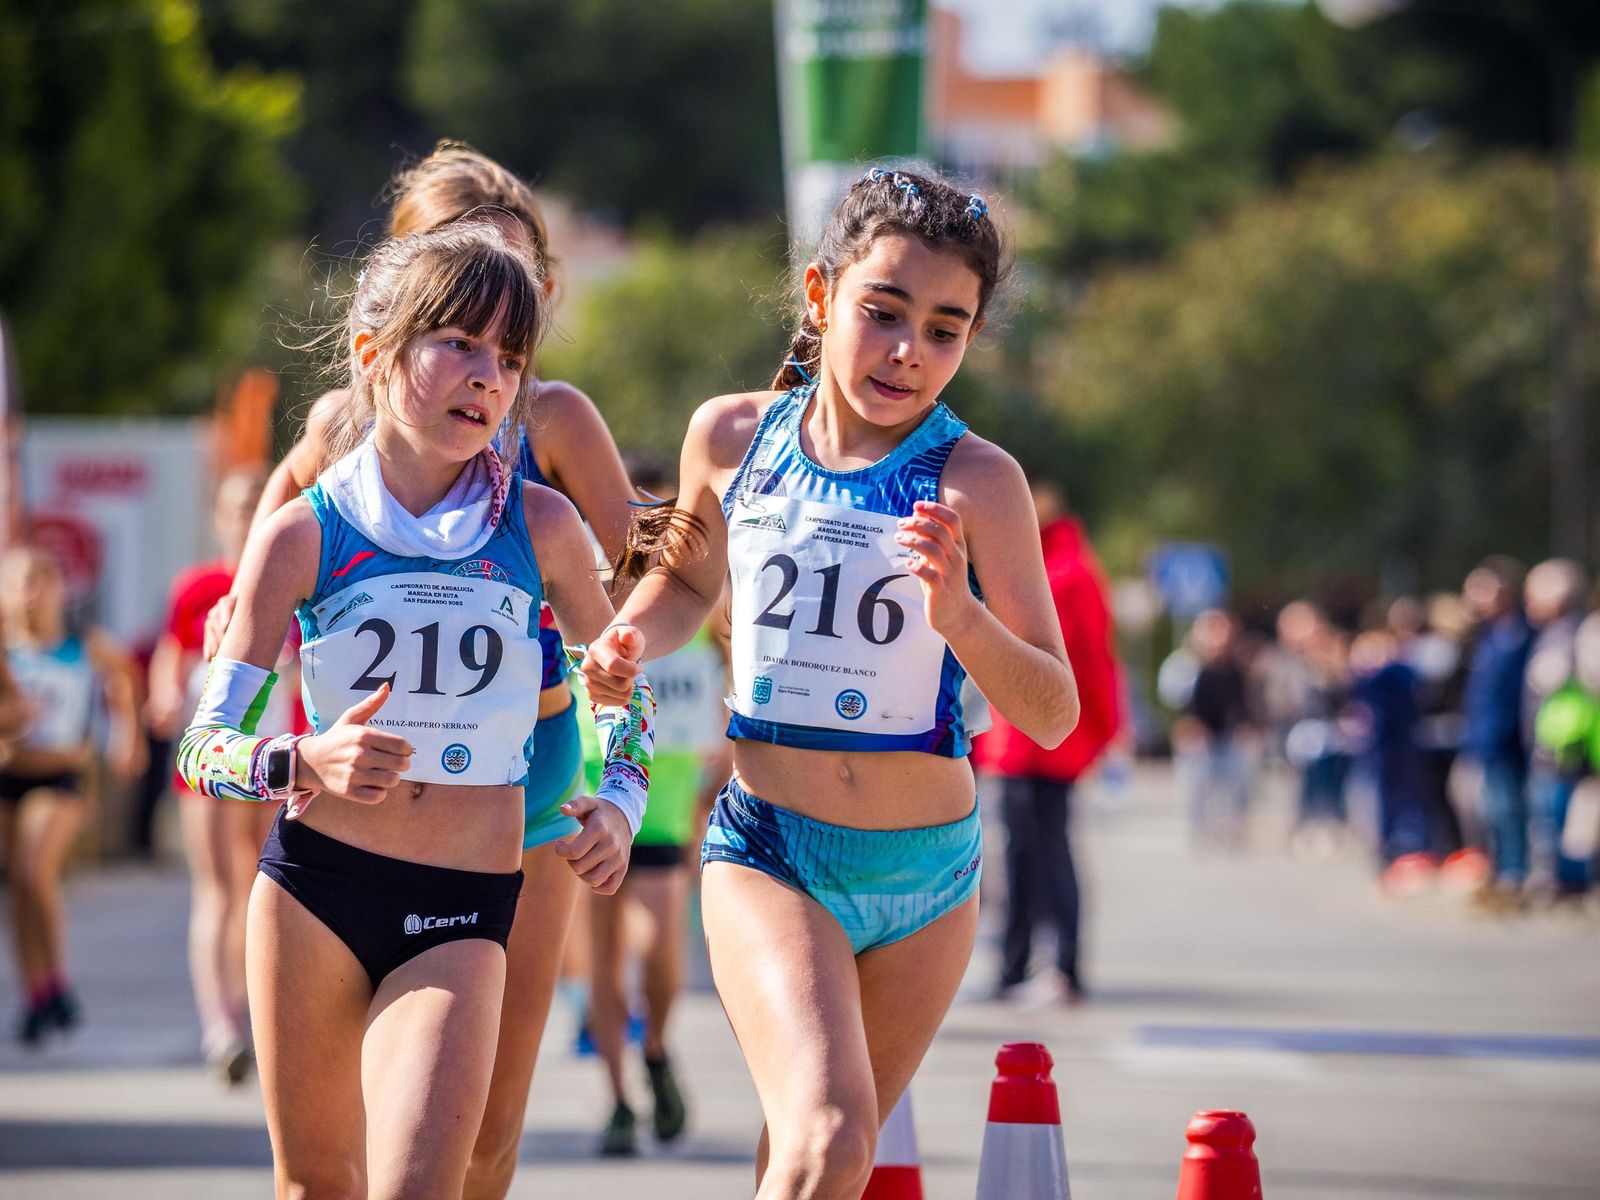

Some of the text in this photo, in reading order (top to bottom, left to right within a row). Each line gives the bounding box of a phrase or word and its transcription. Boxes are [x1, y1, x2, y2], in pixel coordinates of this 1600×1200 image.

[805, 516, 841, 526] CAMPEONATO
[851, 523, 884, 534] ANDALUCÍA
[817, 526, 841, 535] MARCHA
[824, 536, 854, 545] FERNANDO
[753, 554, 909, 645] 216
[350, 618, 503, 697] 219
[763, 655, 877, 678] IDAIRA BOHORQUEZ BLANCO
[386, 720, 440, 729] DIAZ-ROPERO
[442, 722, 478, 730] SERRANO
[423, 912, 478, 929] Cervi
